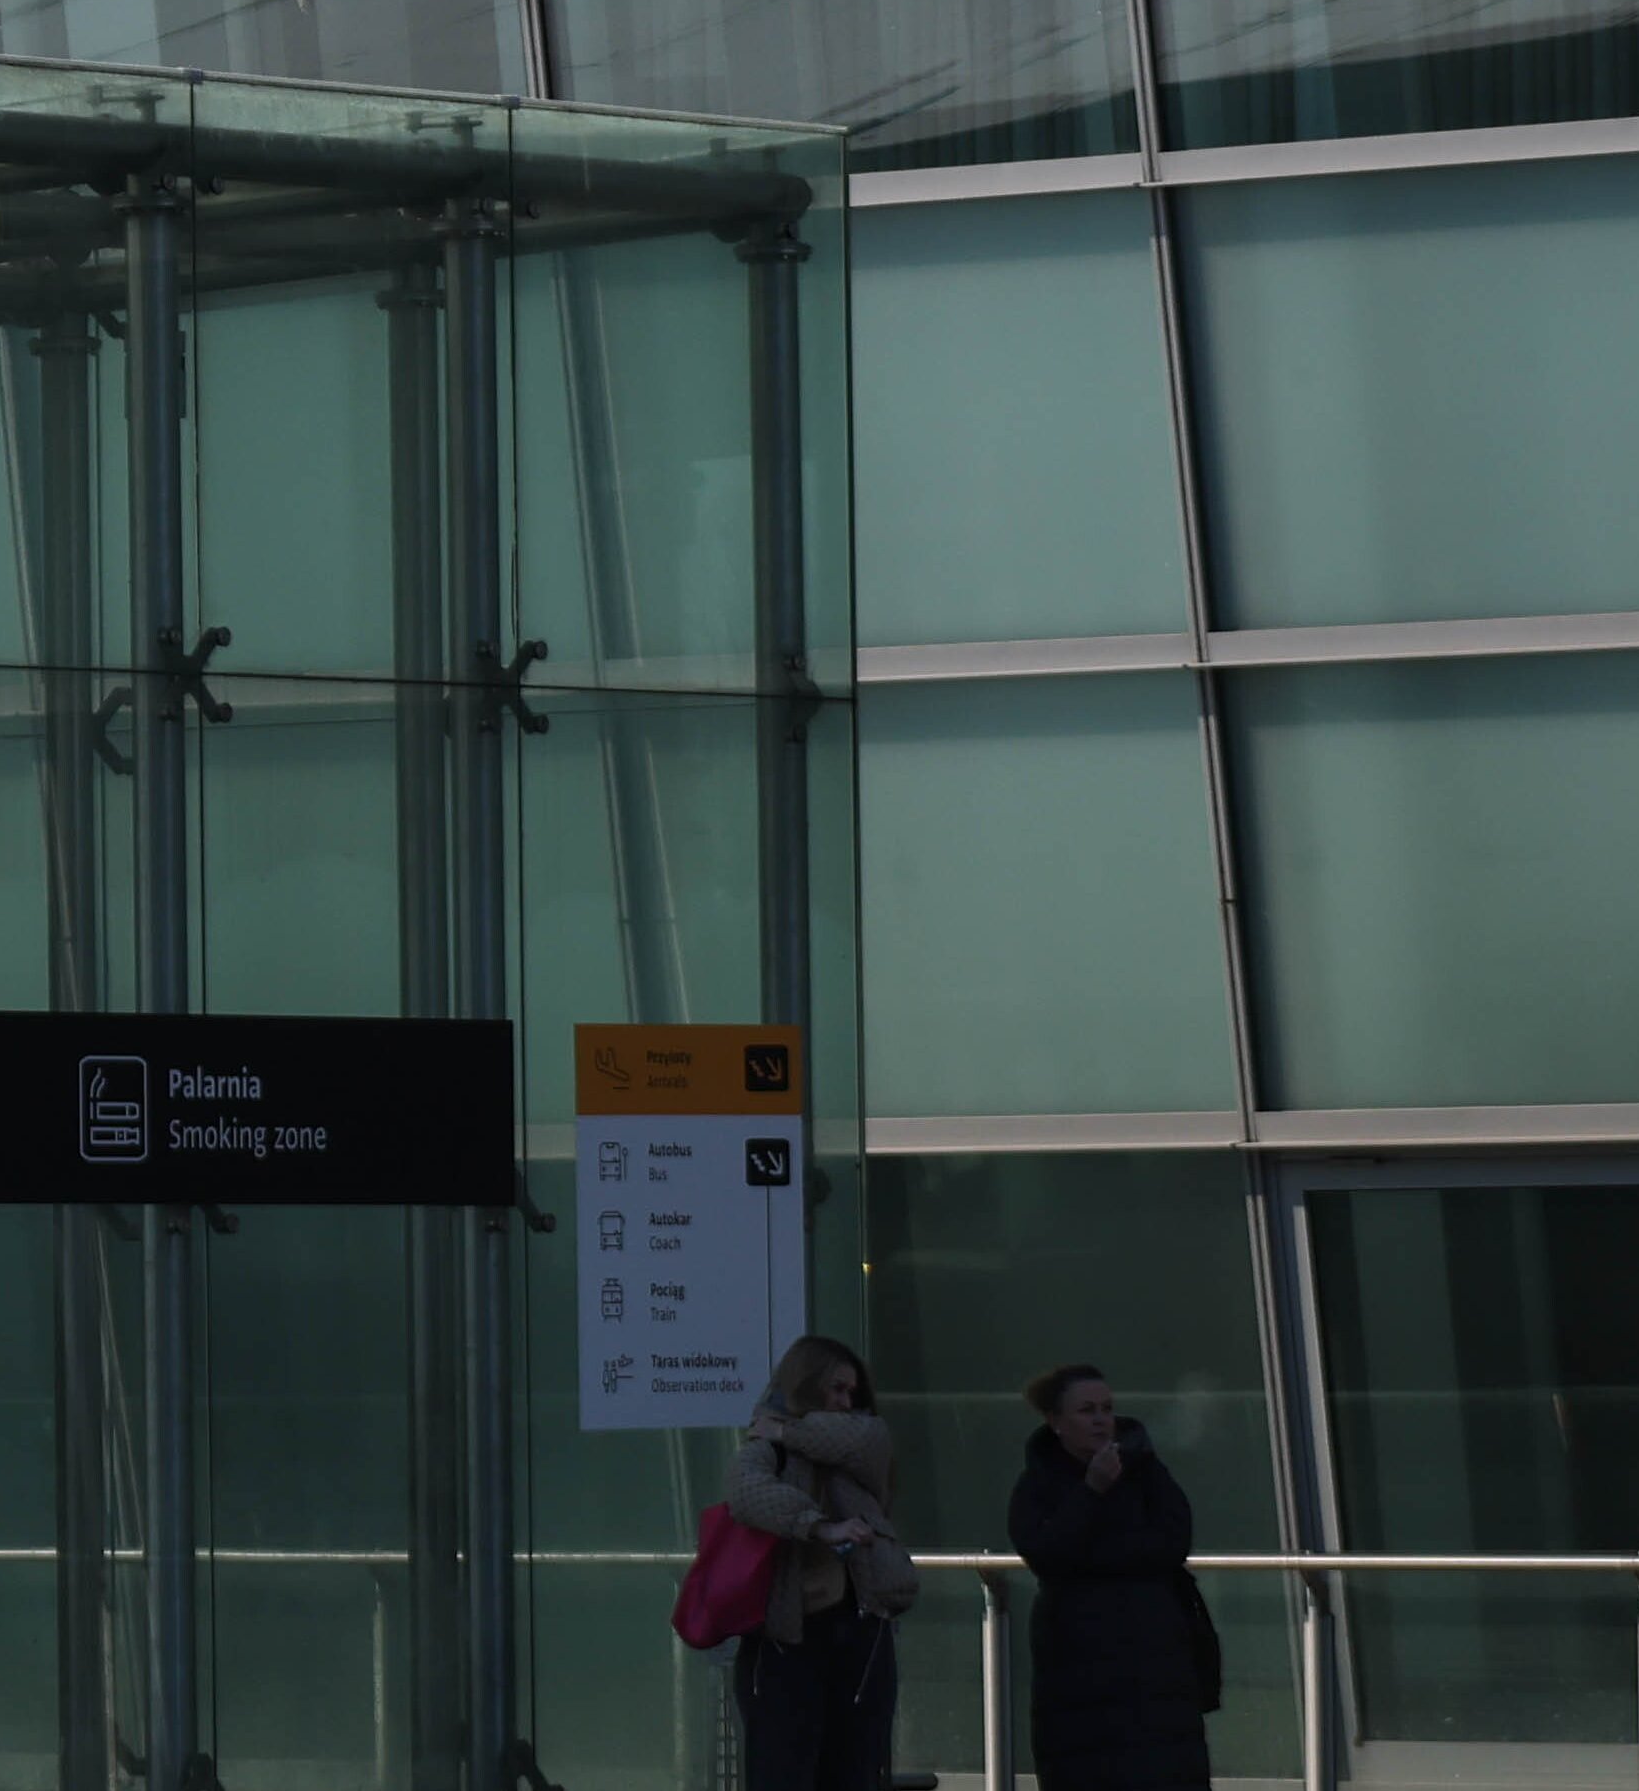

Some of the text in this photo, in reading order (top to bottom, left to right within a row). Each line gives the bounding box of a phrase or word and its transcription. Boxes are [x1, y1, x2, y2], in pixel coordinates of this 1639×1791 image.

[169, 1066, 262, 1099] Palarnia
[169, 1116, 326, 1158] Smoking zone
[648, 1143, 692, 1157] Autobus
[648, 1167, 668, 1181] Bus
[649, 1210, 692, 1225] Autokar
[649, 1236, 681, 1250] Coach
[650, 1281, 685, 1300] Pociąg
[650, 1306, 676, 1321] Train
[651, 1352, 738, 1371] Taras widokowy
[652, 1377, 744, 1393] Observation deck
